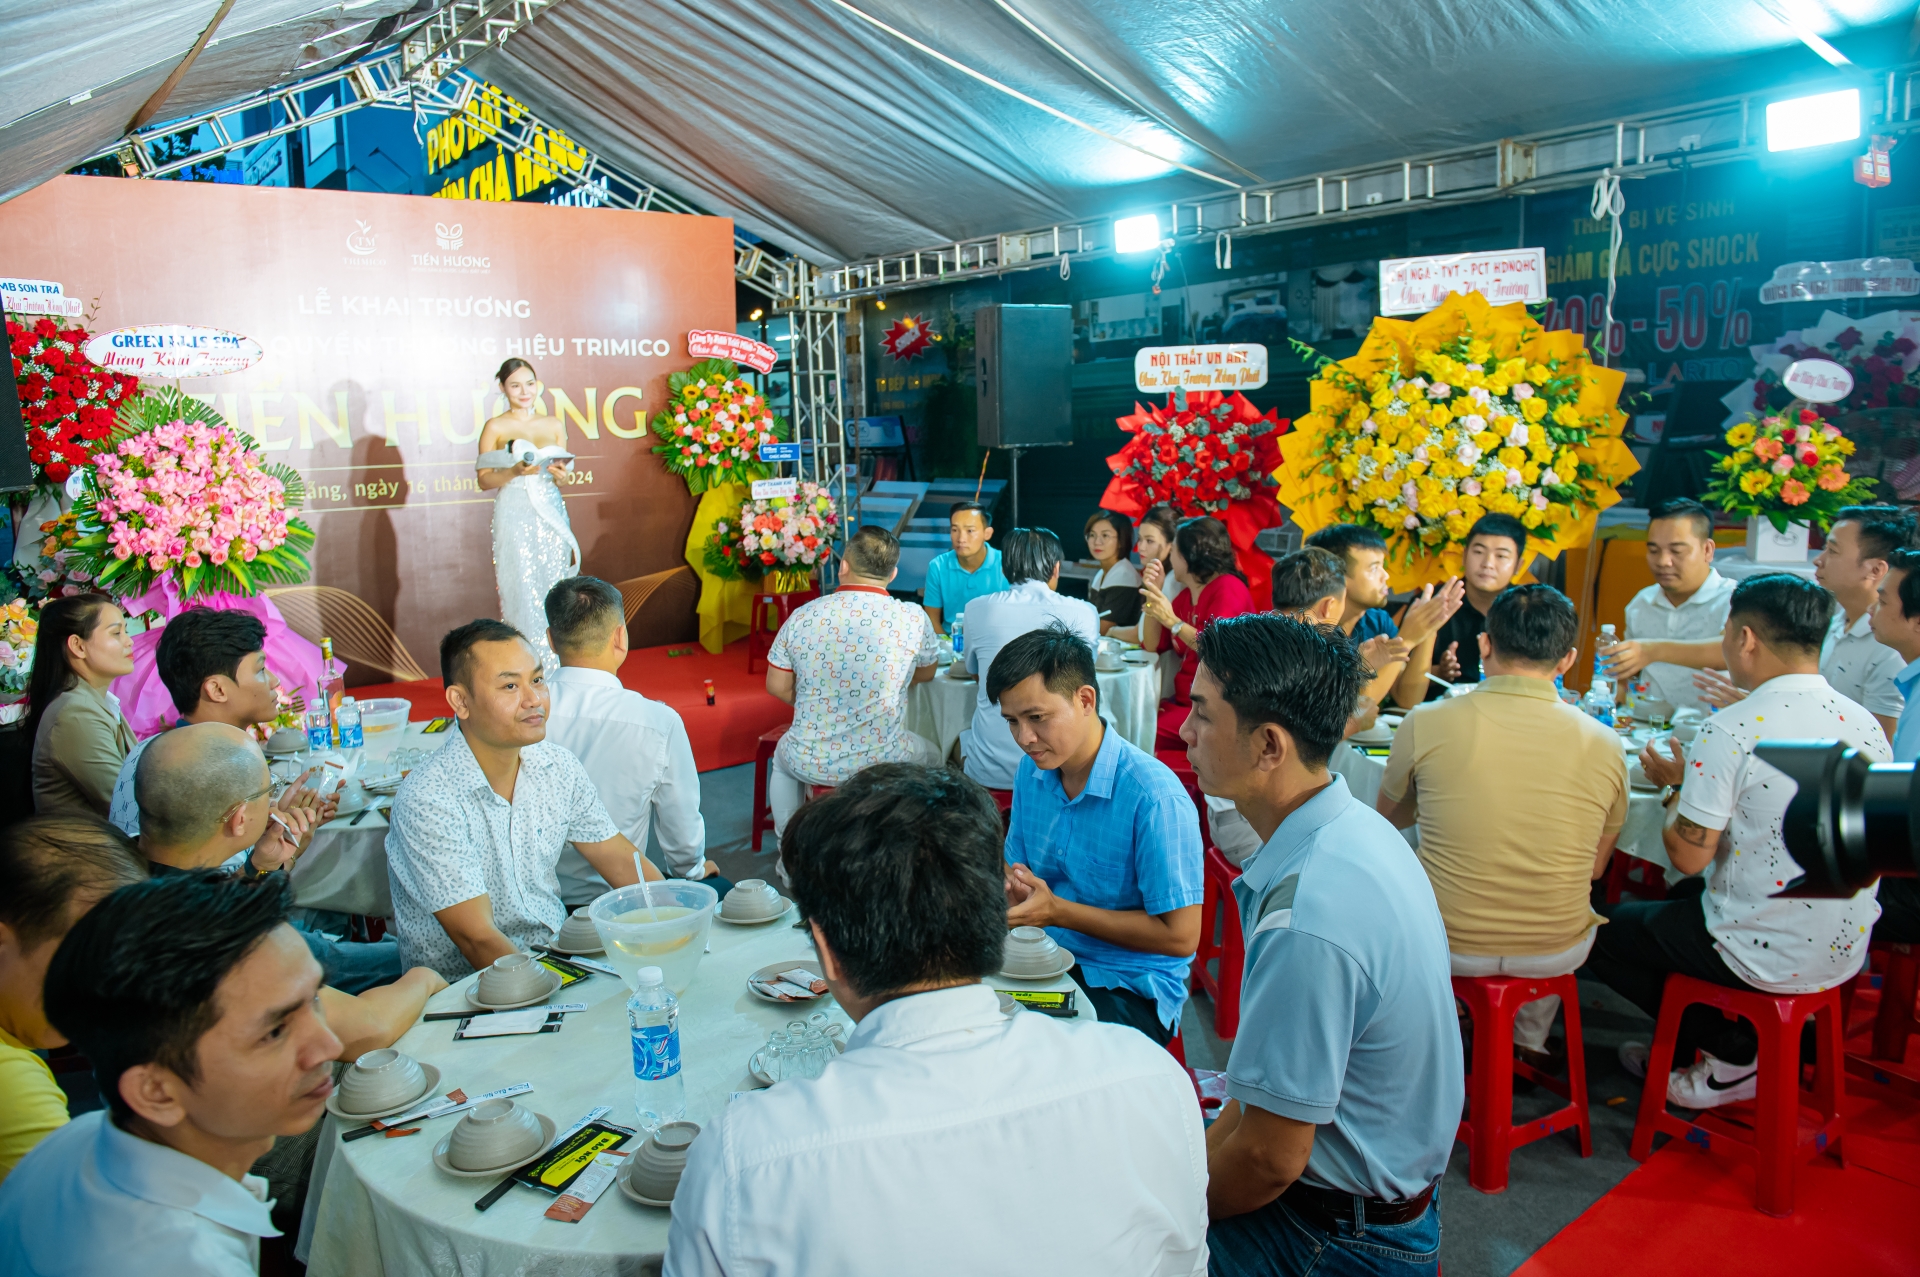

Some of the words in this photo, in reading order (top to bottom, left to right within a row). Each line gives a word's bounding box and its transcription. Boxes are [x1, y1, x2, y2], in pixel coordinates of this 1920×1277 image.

[1685, 199, 1735, 221] SINH
[443, 254, 491, 268] HƯƠNG
[1546, 245, 1594, 285] GIẢM
[1638, 239, 1680, 278] CỰC
[1686, 232, 1760, 269] SHOCK
[1410, 266, 1432, 281] NGA
[1441, 264, 1461, 278] TVT
[1471, 262, 1490, 276] PCT
[17, 283, 39, 293] SƠN
[298, 286, 332, 316] LỄ
[342, 295, 411, 317] KHAI
[418, 295, 531, 319] TRƯƠNG
[1653, 276, 1751, 353] 50%
[112, 334, 164, 348] GREEN
[505, 333, 566, 360] HIỆU
[571, 336, 670, 358] TRIMICO
[102, 351, 145, 368] Mừng
[1150, 351, 1171, 369] NỘI
[1175, 348, 1203, 365] THẤT
[1206, 351, 1222, 364] VN
[304, 478, 348, 501] ẵng,
[354, 476, 400, 501] ngày
[406, 477, 427, 494] 16
[433, 474, 483, 495] tháng
[566, 470, 594, 487] 024
